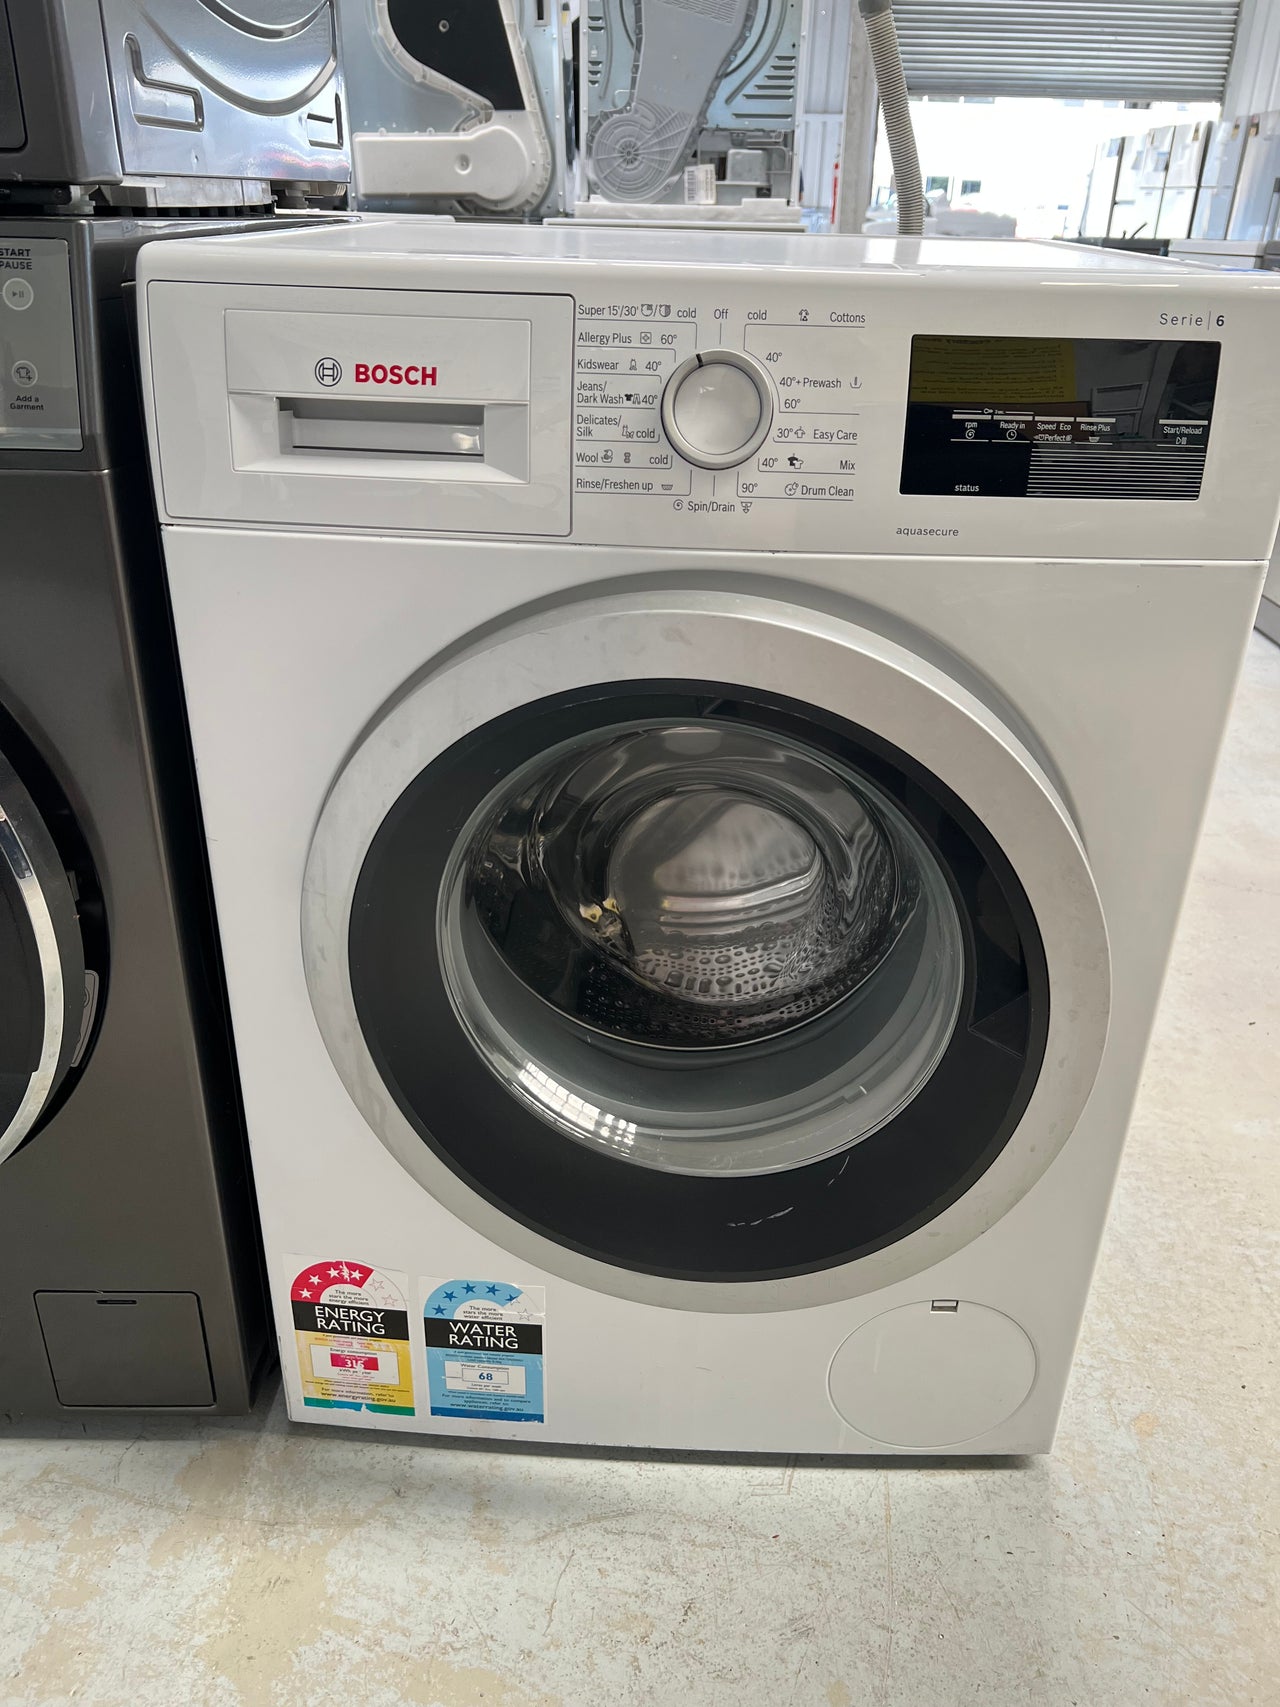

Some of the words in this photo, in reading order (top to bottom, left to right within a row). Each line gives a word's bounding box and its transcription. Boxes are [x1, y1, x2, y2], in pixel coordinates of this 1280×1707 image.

[578, 304, 606, 317] Super
[677, 308, 697, 318] cold
[714, 309, 728, 320] Off
[747, 310, 767, 320] cold
[829, 312, 866, 323] Cottons
[1159, 312, 1204, 326] Serie
[1216, 314, 1225, 327] 6
[578, 332, 611, 345] Allergy
[612, 333, 632, 344] Plus
[660, 334, 678, 344] 60°
[766, 352, 782, 362] 40°
[577, 358, 619, 370] Kidswear
[645, 361, 662, 372] 40°
[355, 364, 437, 386] BOSCH
[577, 381, 608, 393] Jeans/
[802, 378, 842, 388] Prewash
[577, 393, 598, 404] Dark
[600, 394, 624, 404] Wash
[642, 394, 658, 405] 40°
[784, 398, 800, 409] 60°
[10, 402, 44, 410] Garment
[576, 414, 622, 427] Delicates/
[1000, 422, 1019, 430] Ready
[1036, 423, 1056, 431] Speed
[576, 426, 594, 437] Silk
[636, 428, 656, 439] cold
[776, 428, 794, 439] 30°
[813, 429, 834, 442] Easy
[836, 430, 858, 440] Care
[1163, 426, 1202, 434] Start/Reload
[576, 452, 599, 463] Wool
[649, 455, 668, 464] cold
[762, 458, 778, 468] 40°
[839, 460, 856, 470] Mix
[576, 478, 640, 490] Rinse/Freshen
[641, 483, 654, 492] up
[741, 483, 758, 493] 90°
[800, 485, 826, 496] Drum
[828, 486, 854, 497] Clean
[954, 484, 980, 492] status
[687, 500, 736, 513] Spin/Drain
[896, 527, 959, 537] aquasecure
[314, 1306, 385, 1322] ENERGY
[317, 1318, 386, 1335] RATING
[449, 1322, 517, 1337] WATER
[449, 1334, 519, 1349] RATING
[478, 1372, 493, 1380] 68
